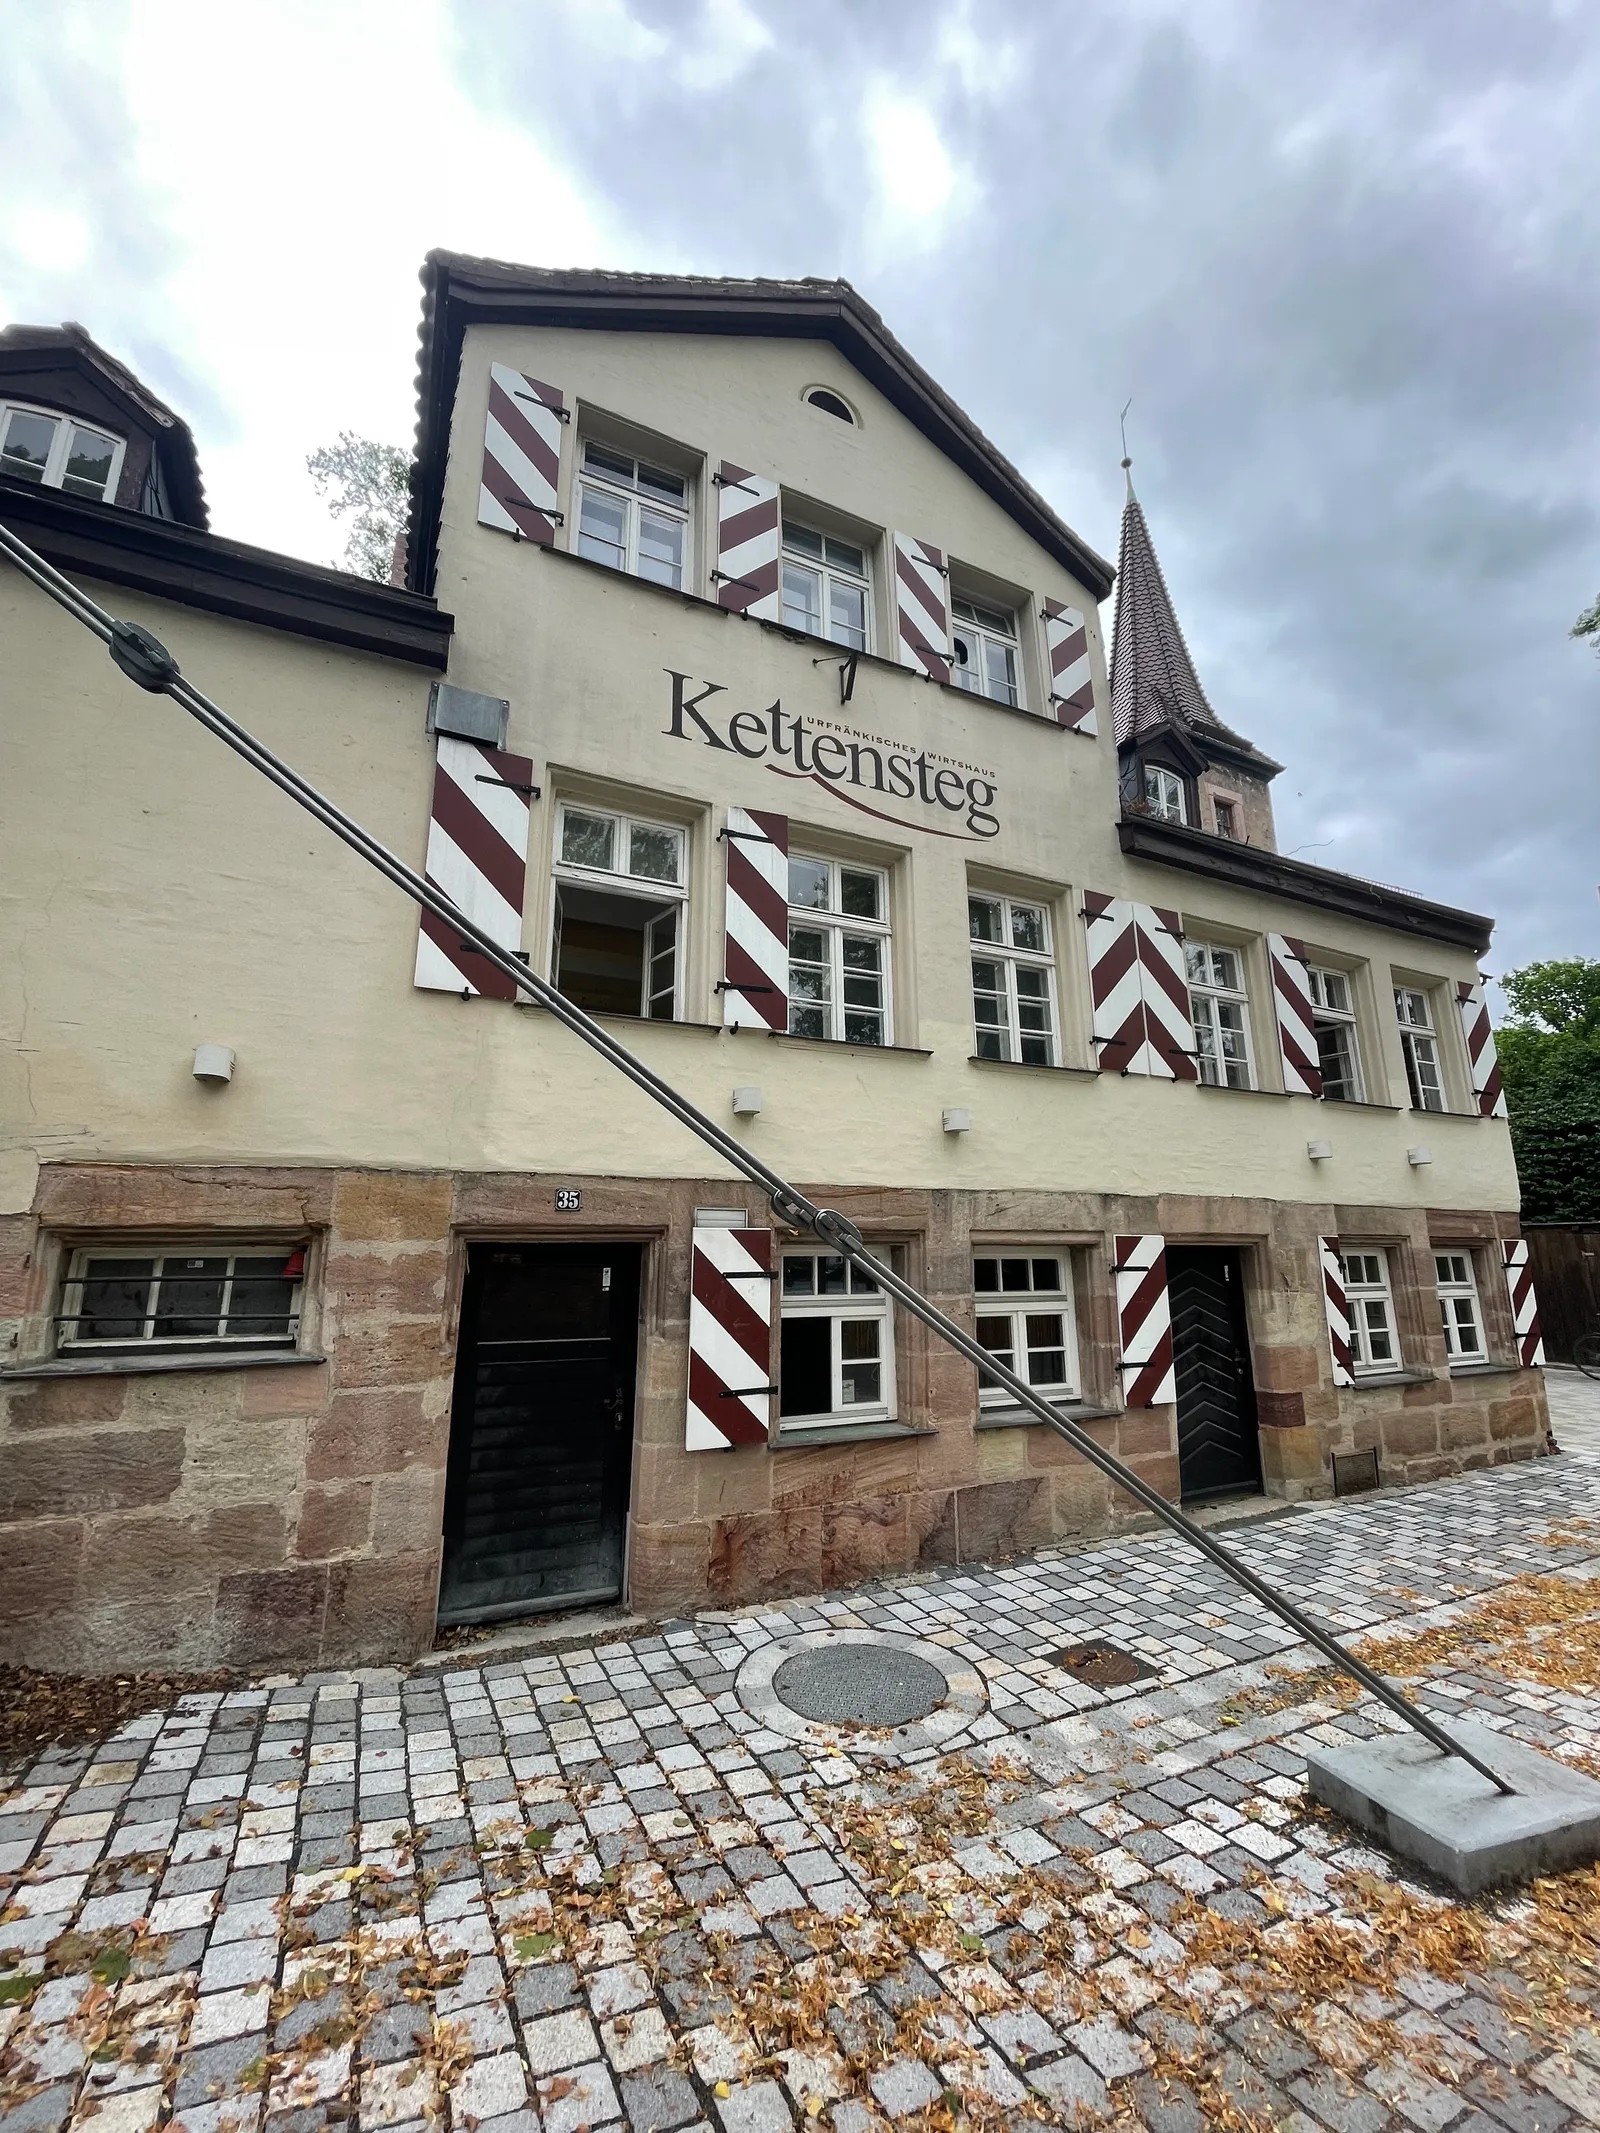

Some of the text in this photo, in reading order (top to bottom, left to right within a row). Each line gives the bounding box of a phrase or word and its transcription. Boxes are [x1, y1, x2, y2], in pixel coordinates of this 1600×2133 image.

[661, 668, 1000, 837] Kettensteg
[807, 716, 996, 778] URFRÄNKISCHES WIRTSHAUS
[558, 1191, 579, 1208] 35
